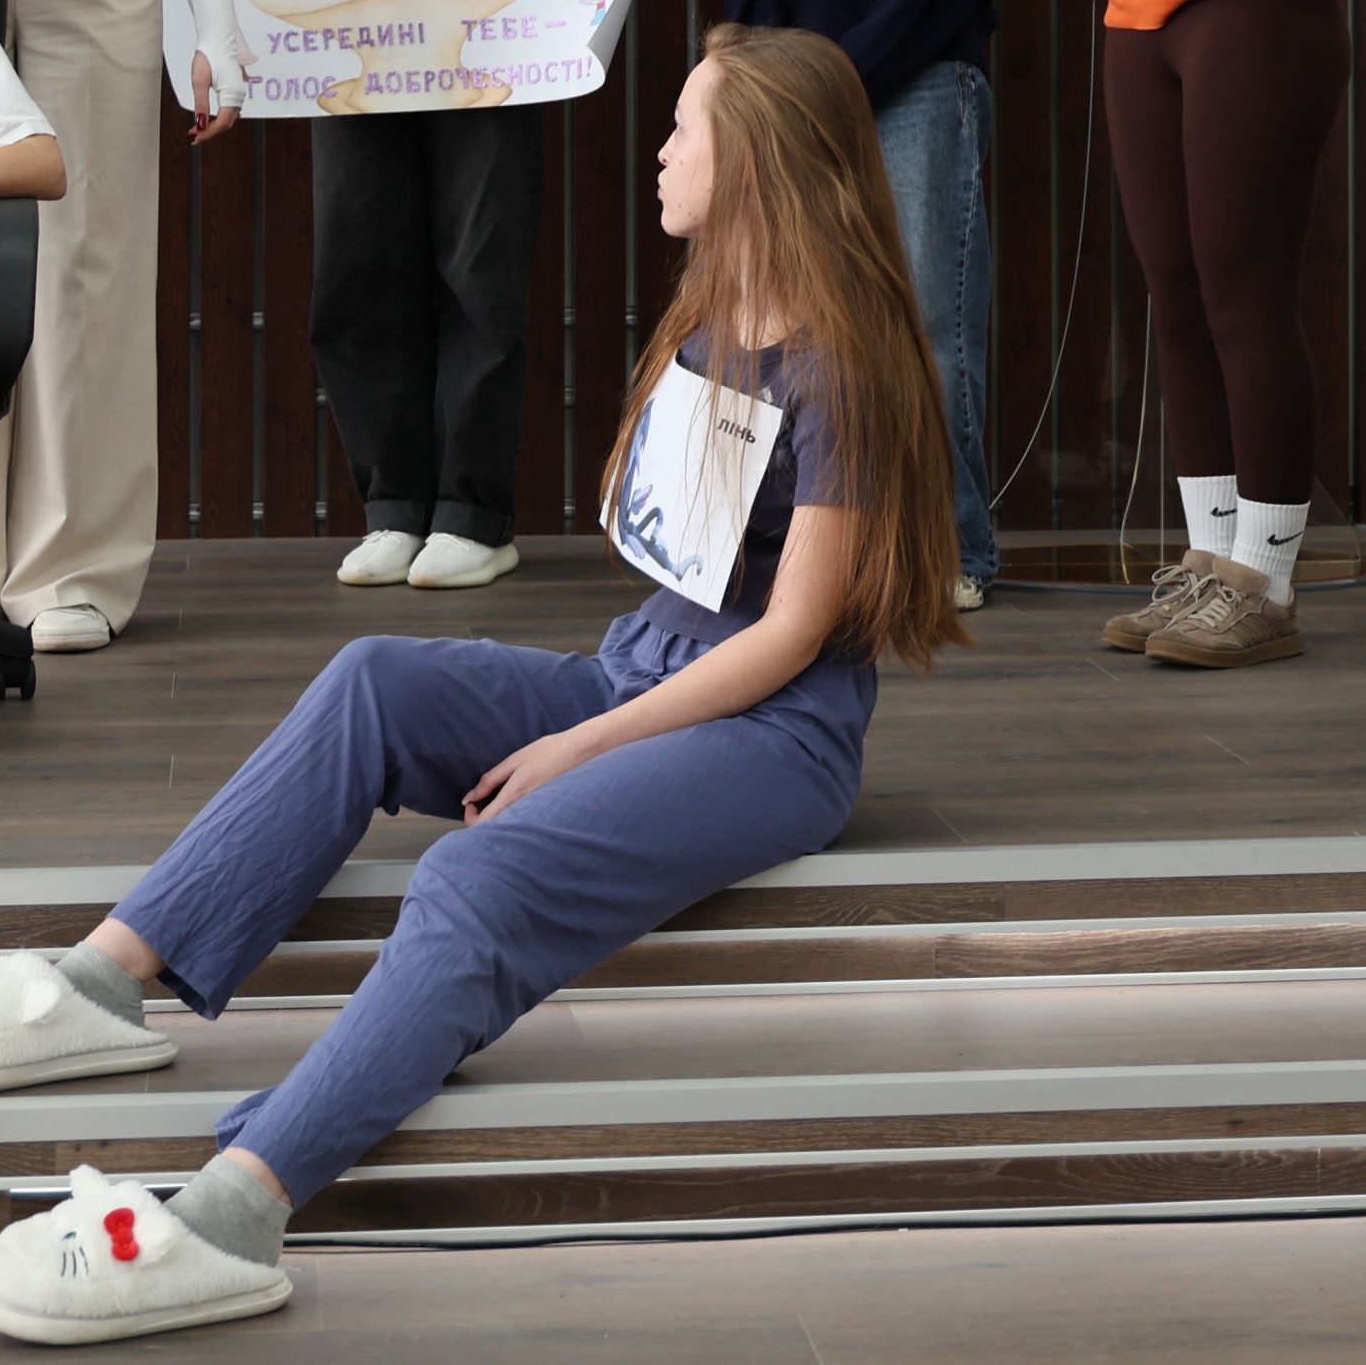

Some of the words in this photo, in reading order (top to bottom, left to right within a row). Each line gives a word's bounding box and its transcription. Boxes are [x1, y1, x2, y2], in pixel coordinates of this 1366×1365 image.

[267, 22, 425, 54] УСЕРЕДИНІ
[246, 75, 338, 101] ГОЛОС
[364, 56, 592, 97] ДОБРОЧЕСНОСТІ!
[716, 417, 757, 445] ЛІНЬ
